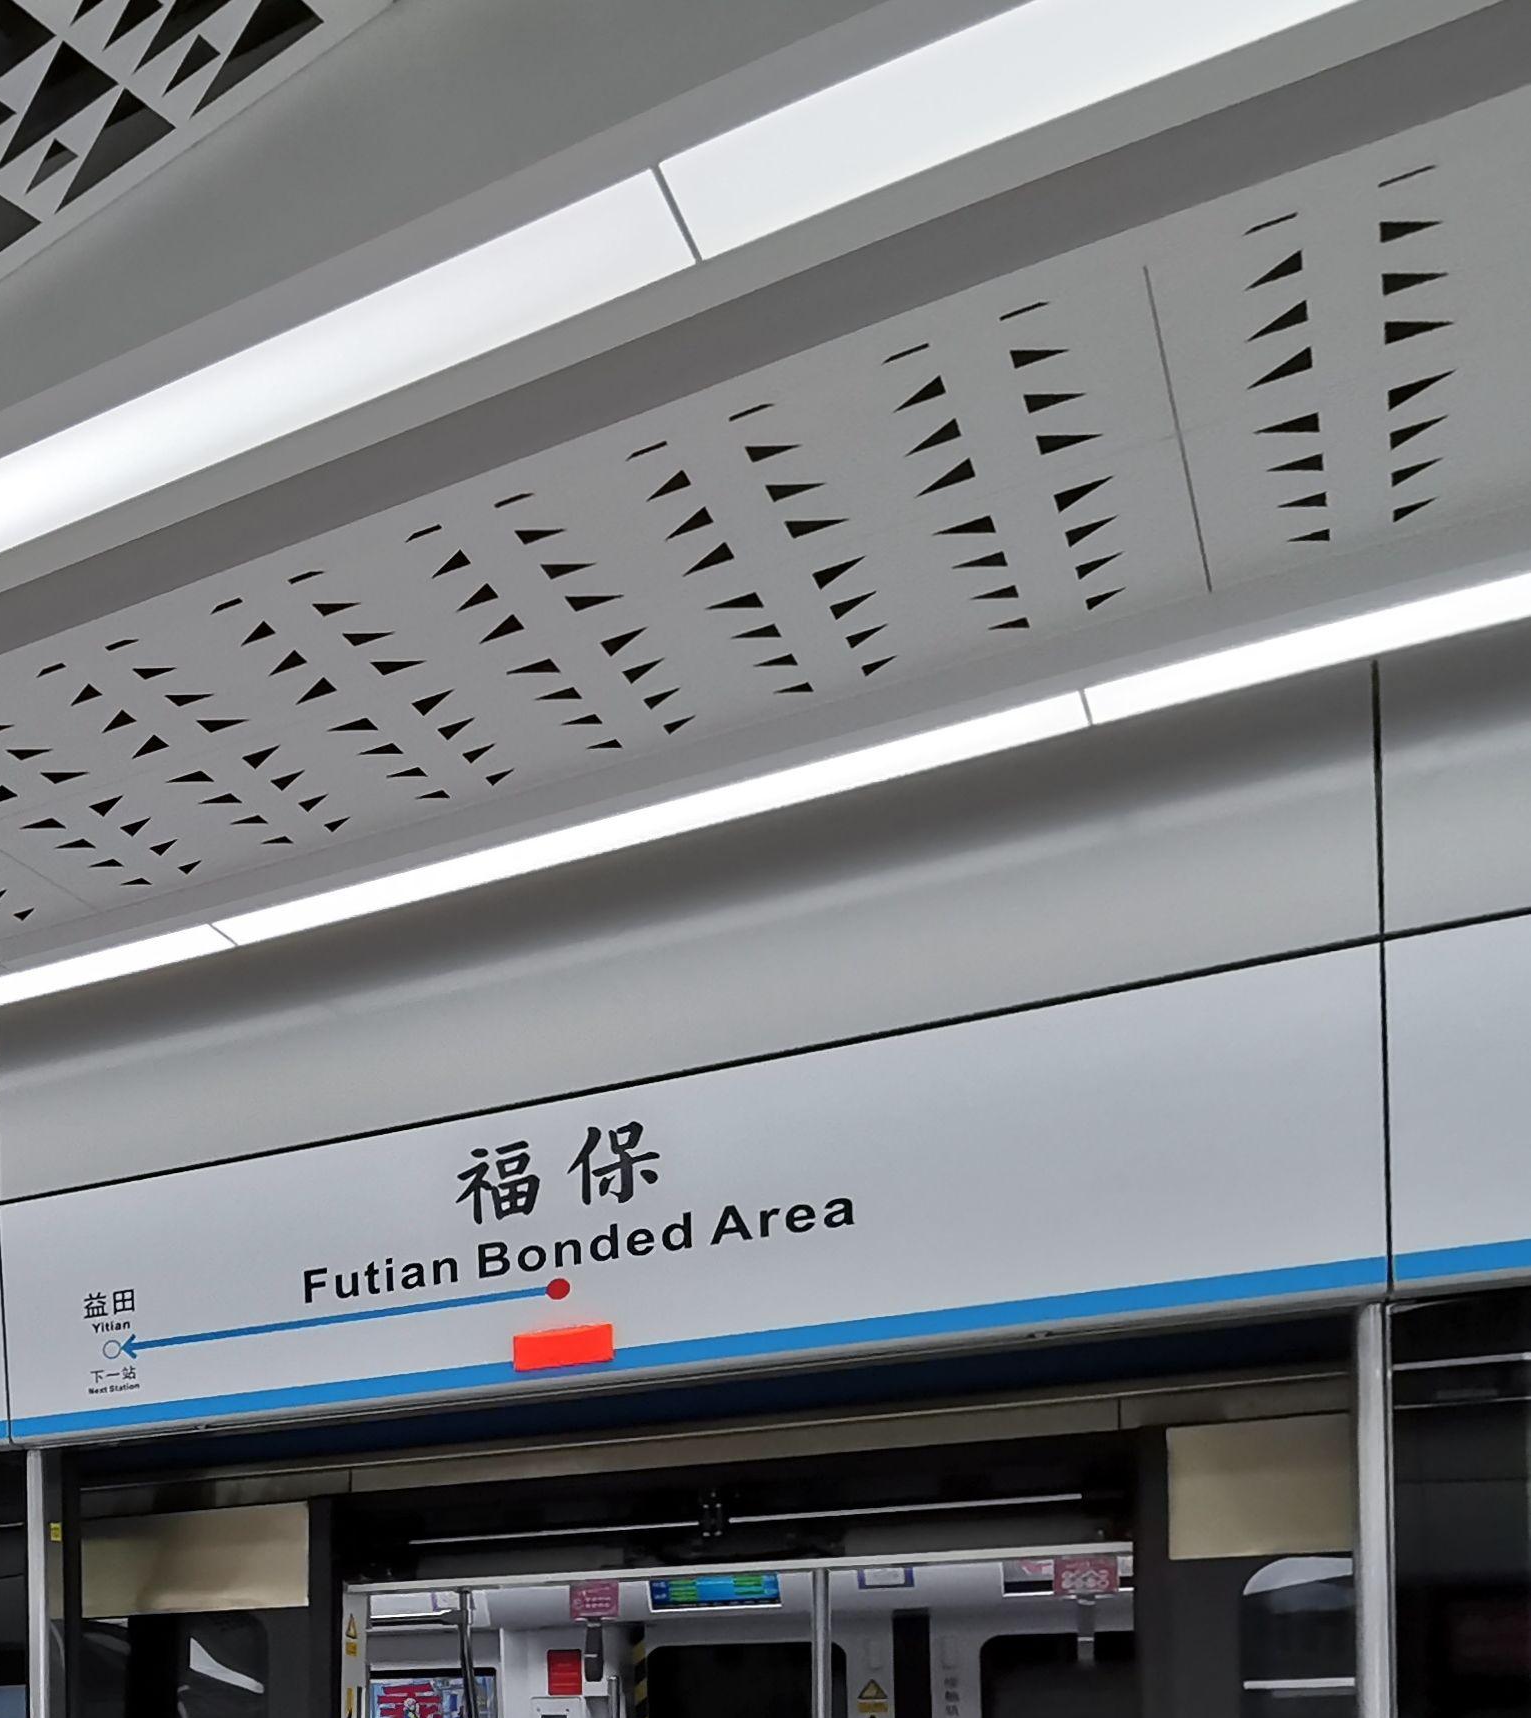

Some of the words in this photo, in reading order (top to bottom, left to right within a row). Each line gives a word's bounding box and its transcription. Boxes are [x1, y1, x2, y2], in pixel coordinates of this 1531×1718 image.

[455, 1120, 661, 1226] 福保
[303, 1256, 459, 1304] Futian
[477, 1212, 693, 1278] Bonded
[710, 1196, 856, 1246] Area
[83, 1289, 136, 1319] 益田
[92, 1321, 131, 1334] Yitian
[89, 1365, 137, 1384] 下一站
